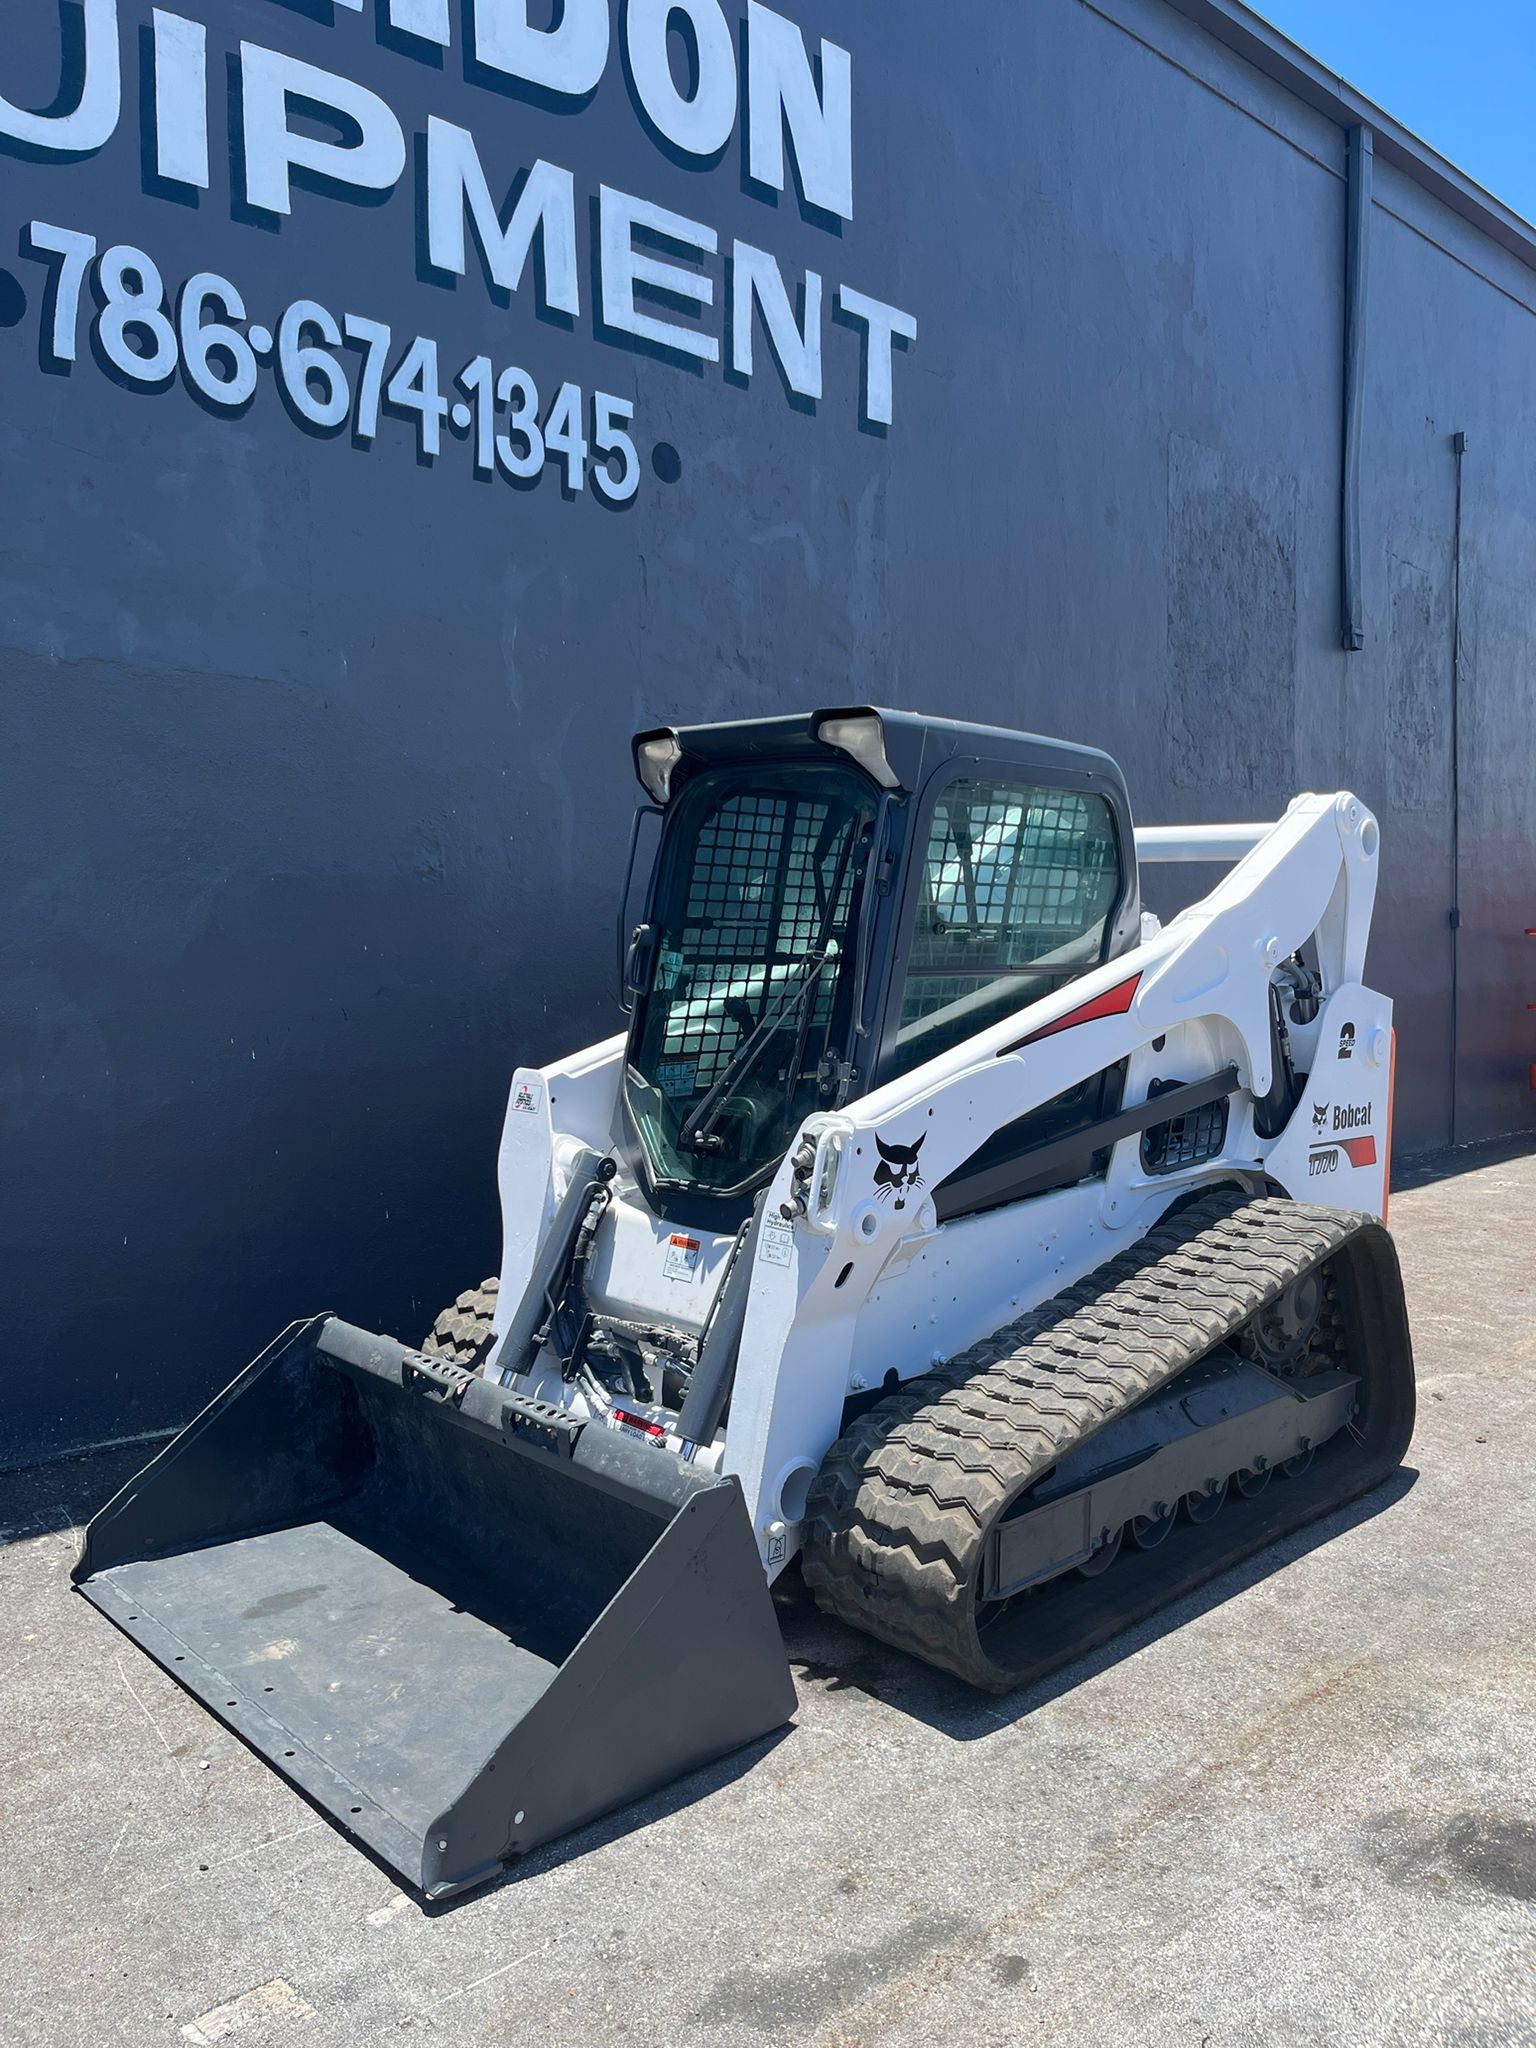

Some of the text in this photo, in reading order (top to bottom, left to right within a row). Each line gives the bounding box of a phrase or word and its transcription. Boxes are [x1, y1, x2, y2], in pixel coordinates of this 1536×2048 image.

[1339, 1038, 1357, 1048] SPEED
[1333, 1102, 1372, 1131] Bobcat
[1309, 1150, 1338, 1176] T770
